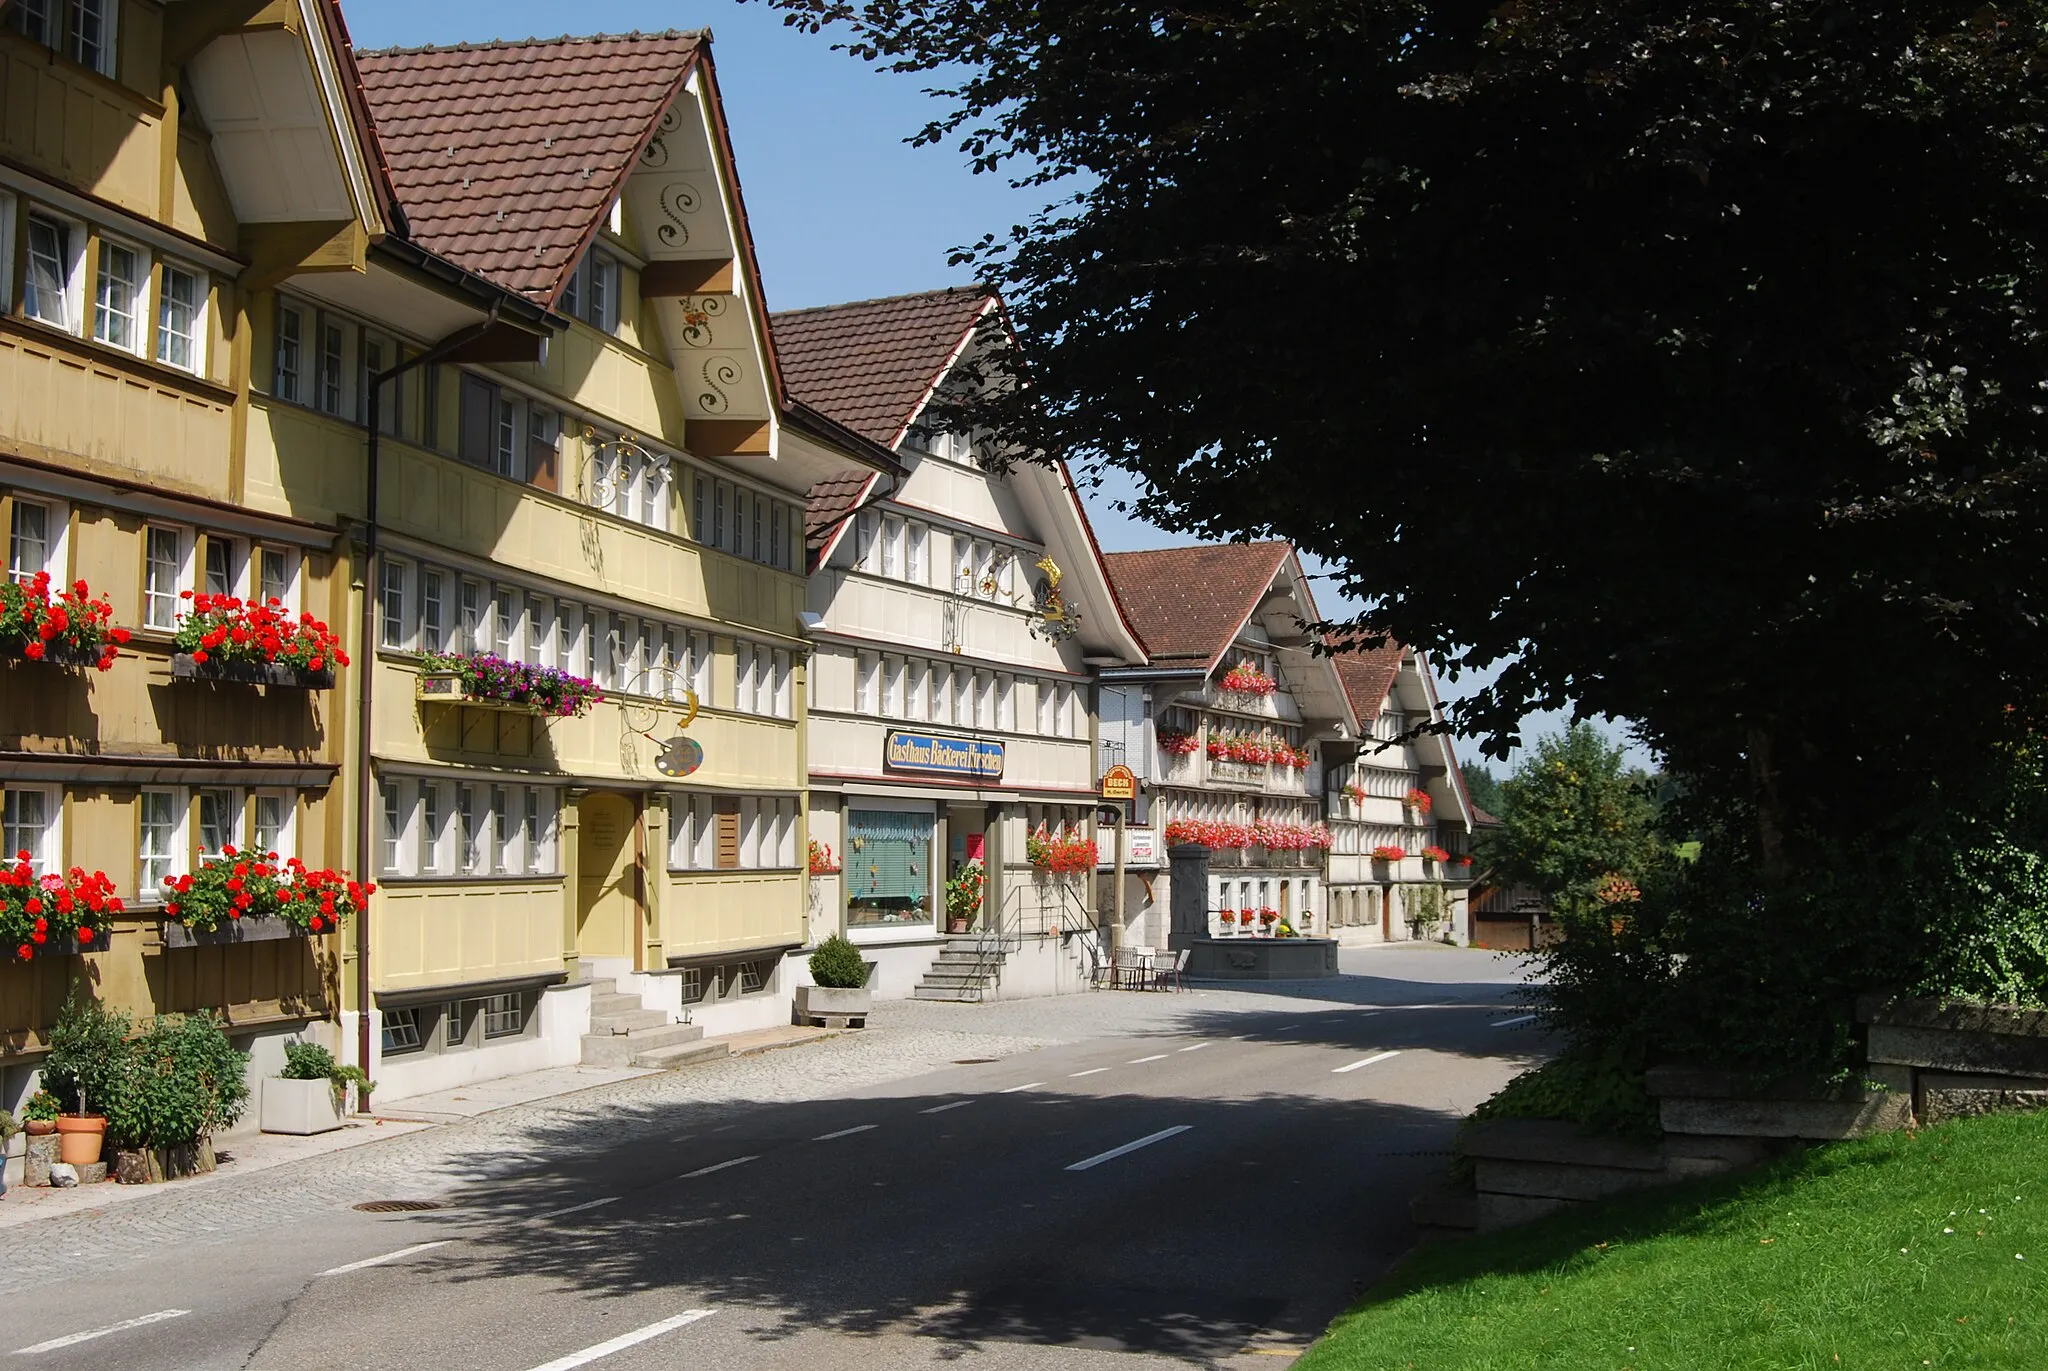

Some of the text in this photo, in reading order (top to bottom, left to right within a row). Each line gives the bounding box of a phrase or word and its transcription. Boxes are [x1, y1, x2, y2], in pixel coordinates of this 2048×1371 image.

[889, 736, 1002, 771] Gasthaus Bäckerei Hirschen
[1107, 778, 1129, 787] BECK
